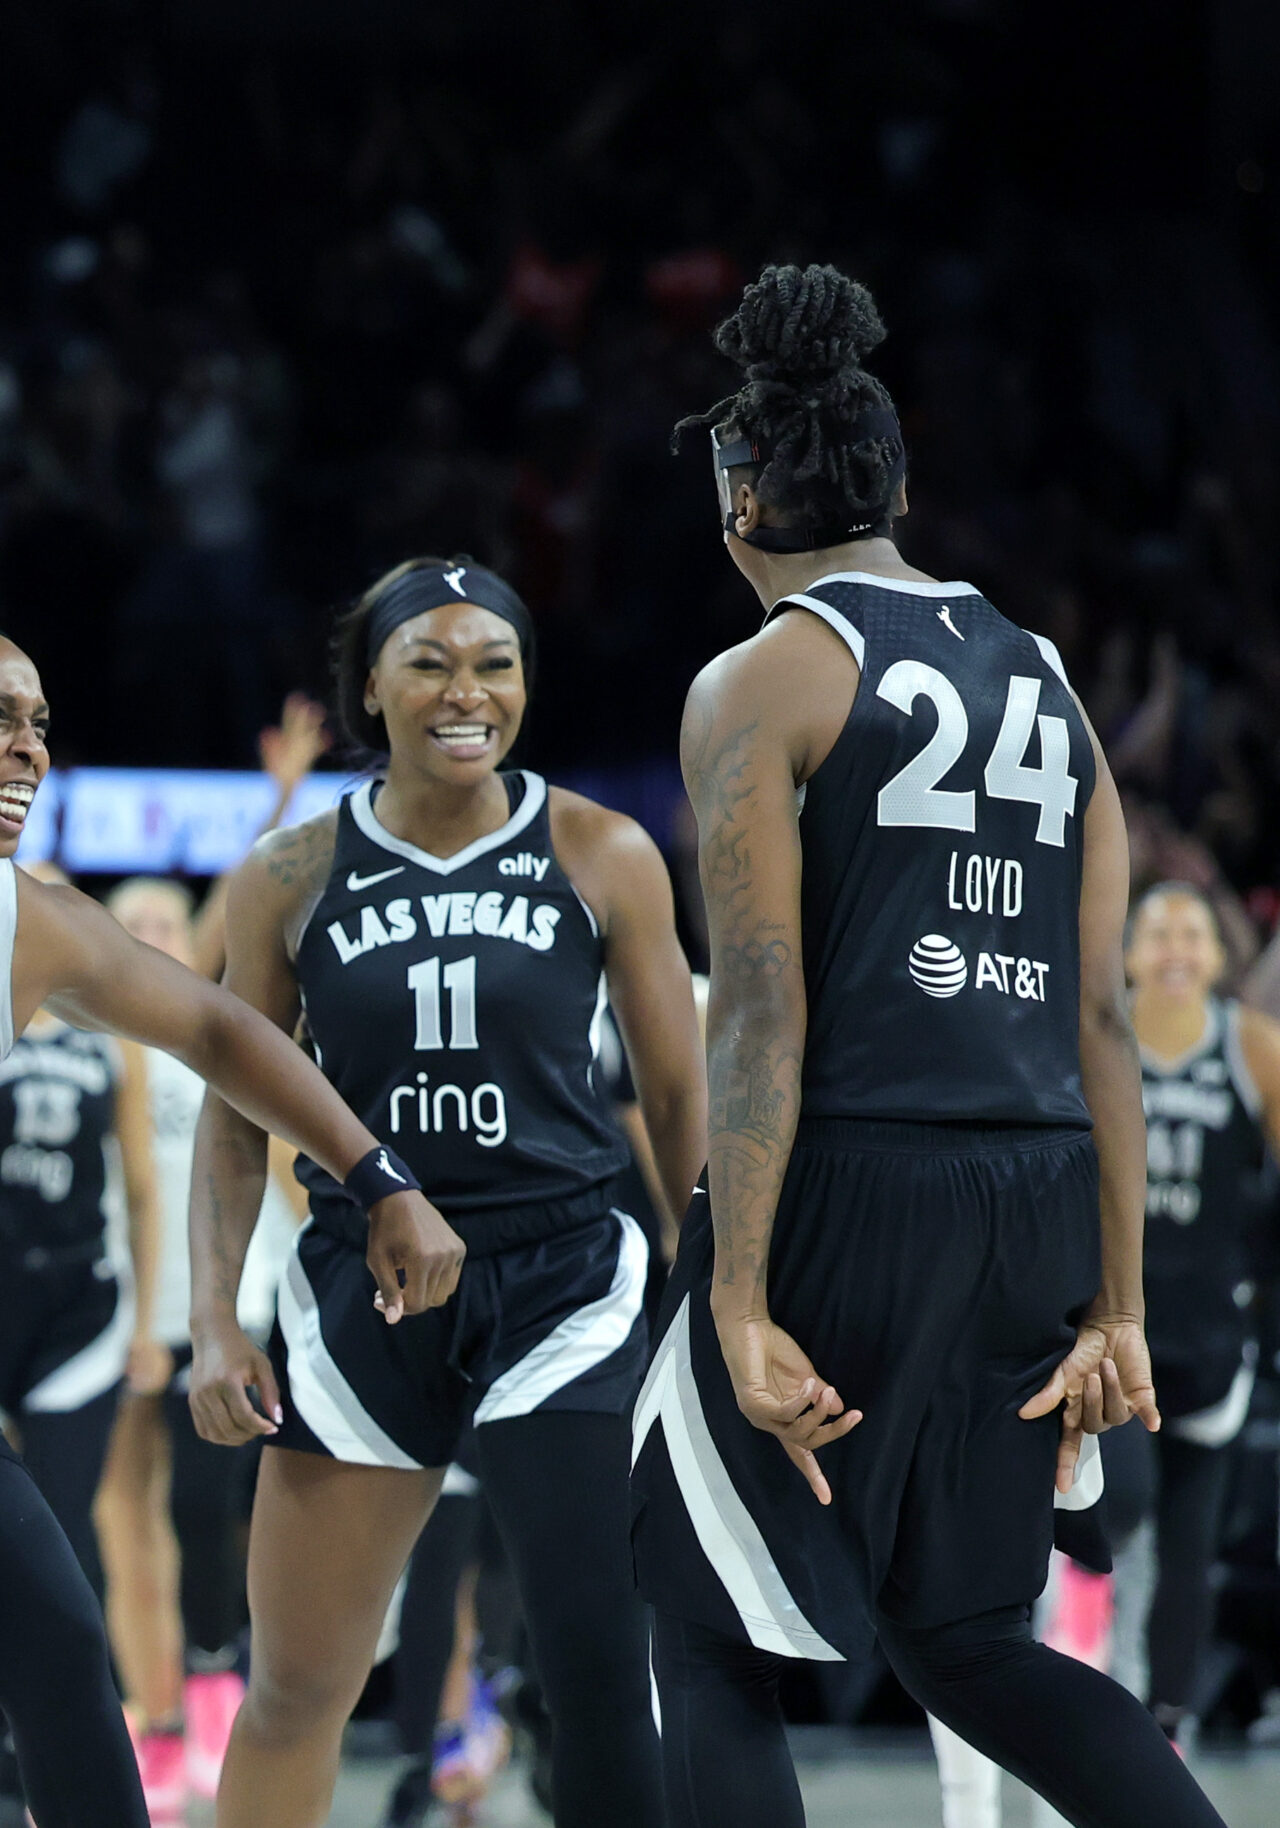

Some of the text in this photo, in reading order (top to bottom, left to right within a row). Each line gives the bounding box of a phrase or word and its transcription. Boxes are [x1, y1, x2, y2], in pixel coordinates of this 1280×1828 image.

[876, 659, 1079, 848] 24
[498, 852, 550, 882] ally
[948, 851, 1023, 918] LOYD
[327, 891, 561, 965] LAS VEGAS
[407, 955, 479, 1051] 11
[975, 952, 1050, 1002] AT&T
[389, 1071, 508, 1148] ring
